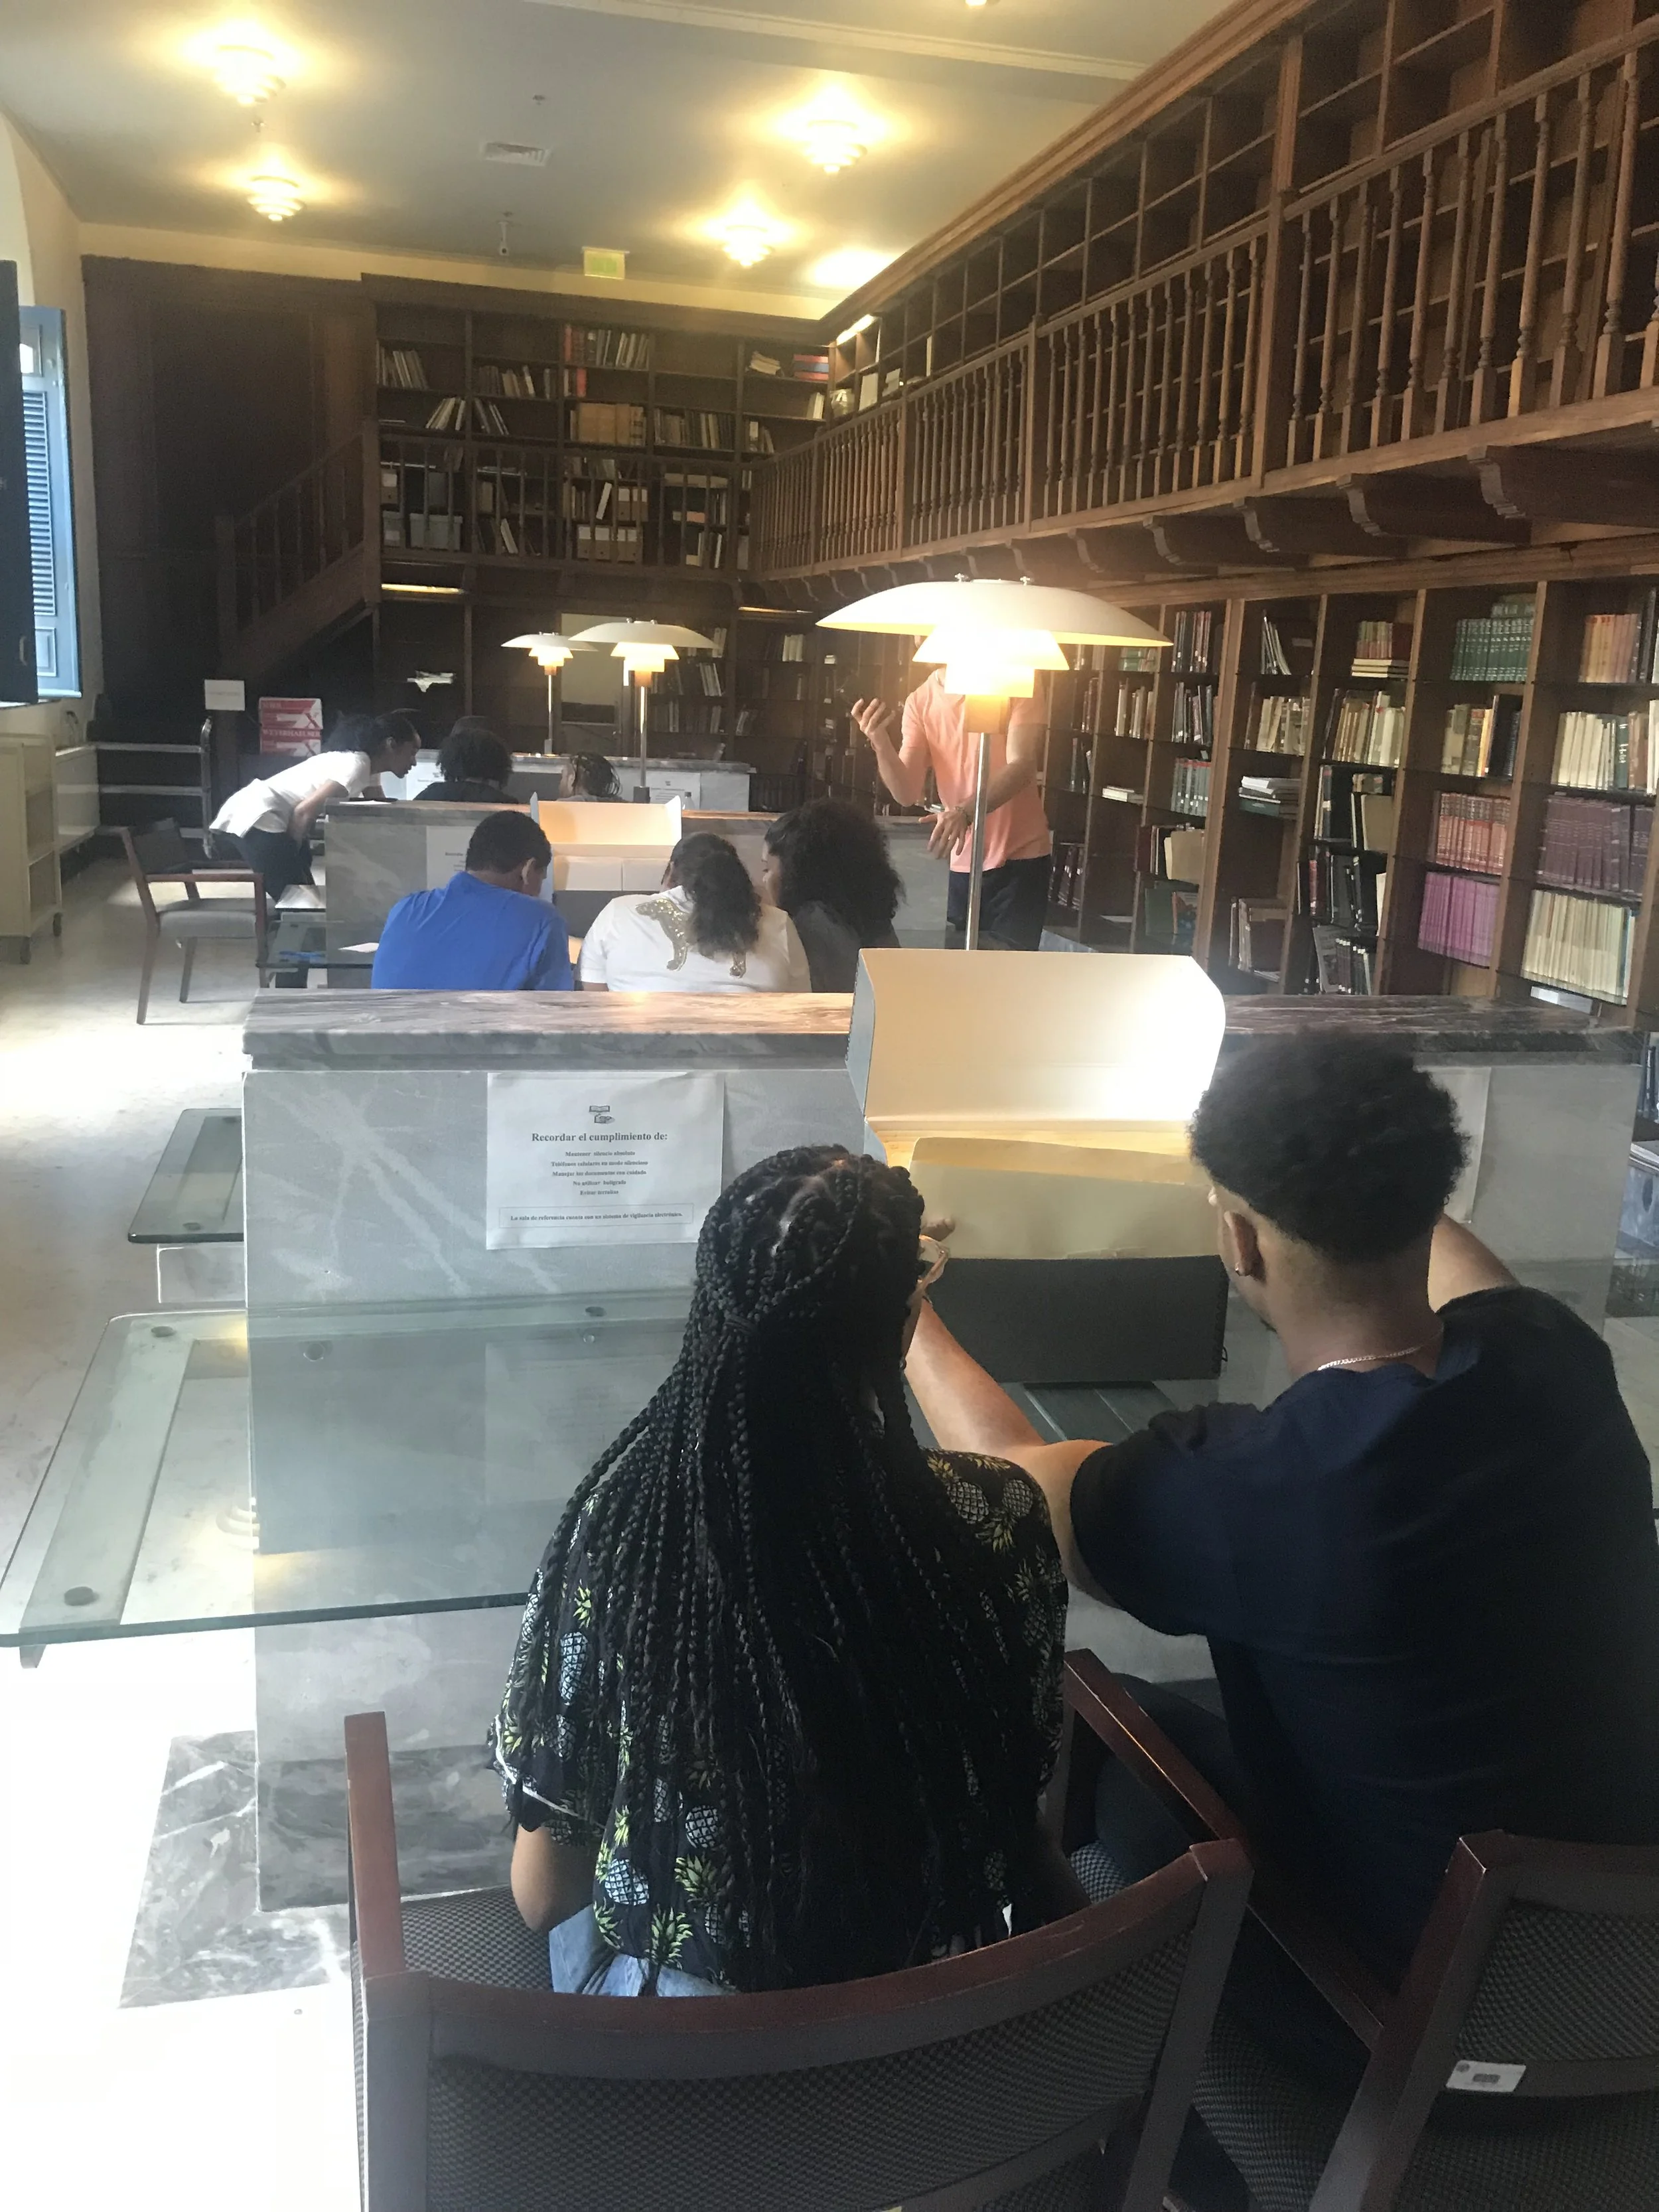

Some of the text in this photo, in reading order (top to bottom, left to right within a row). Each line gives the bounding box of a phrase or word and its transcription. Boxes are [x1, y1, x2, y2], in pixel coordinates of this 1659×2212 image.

[532, 1132, 668, 1143] Recordar el cumplimiento de:
